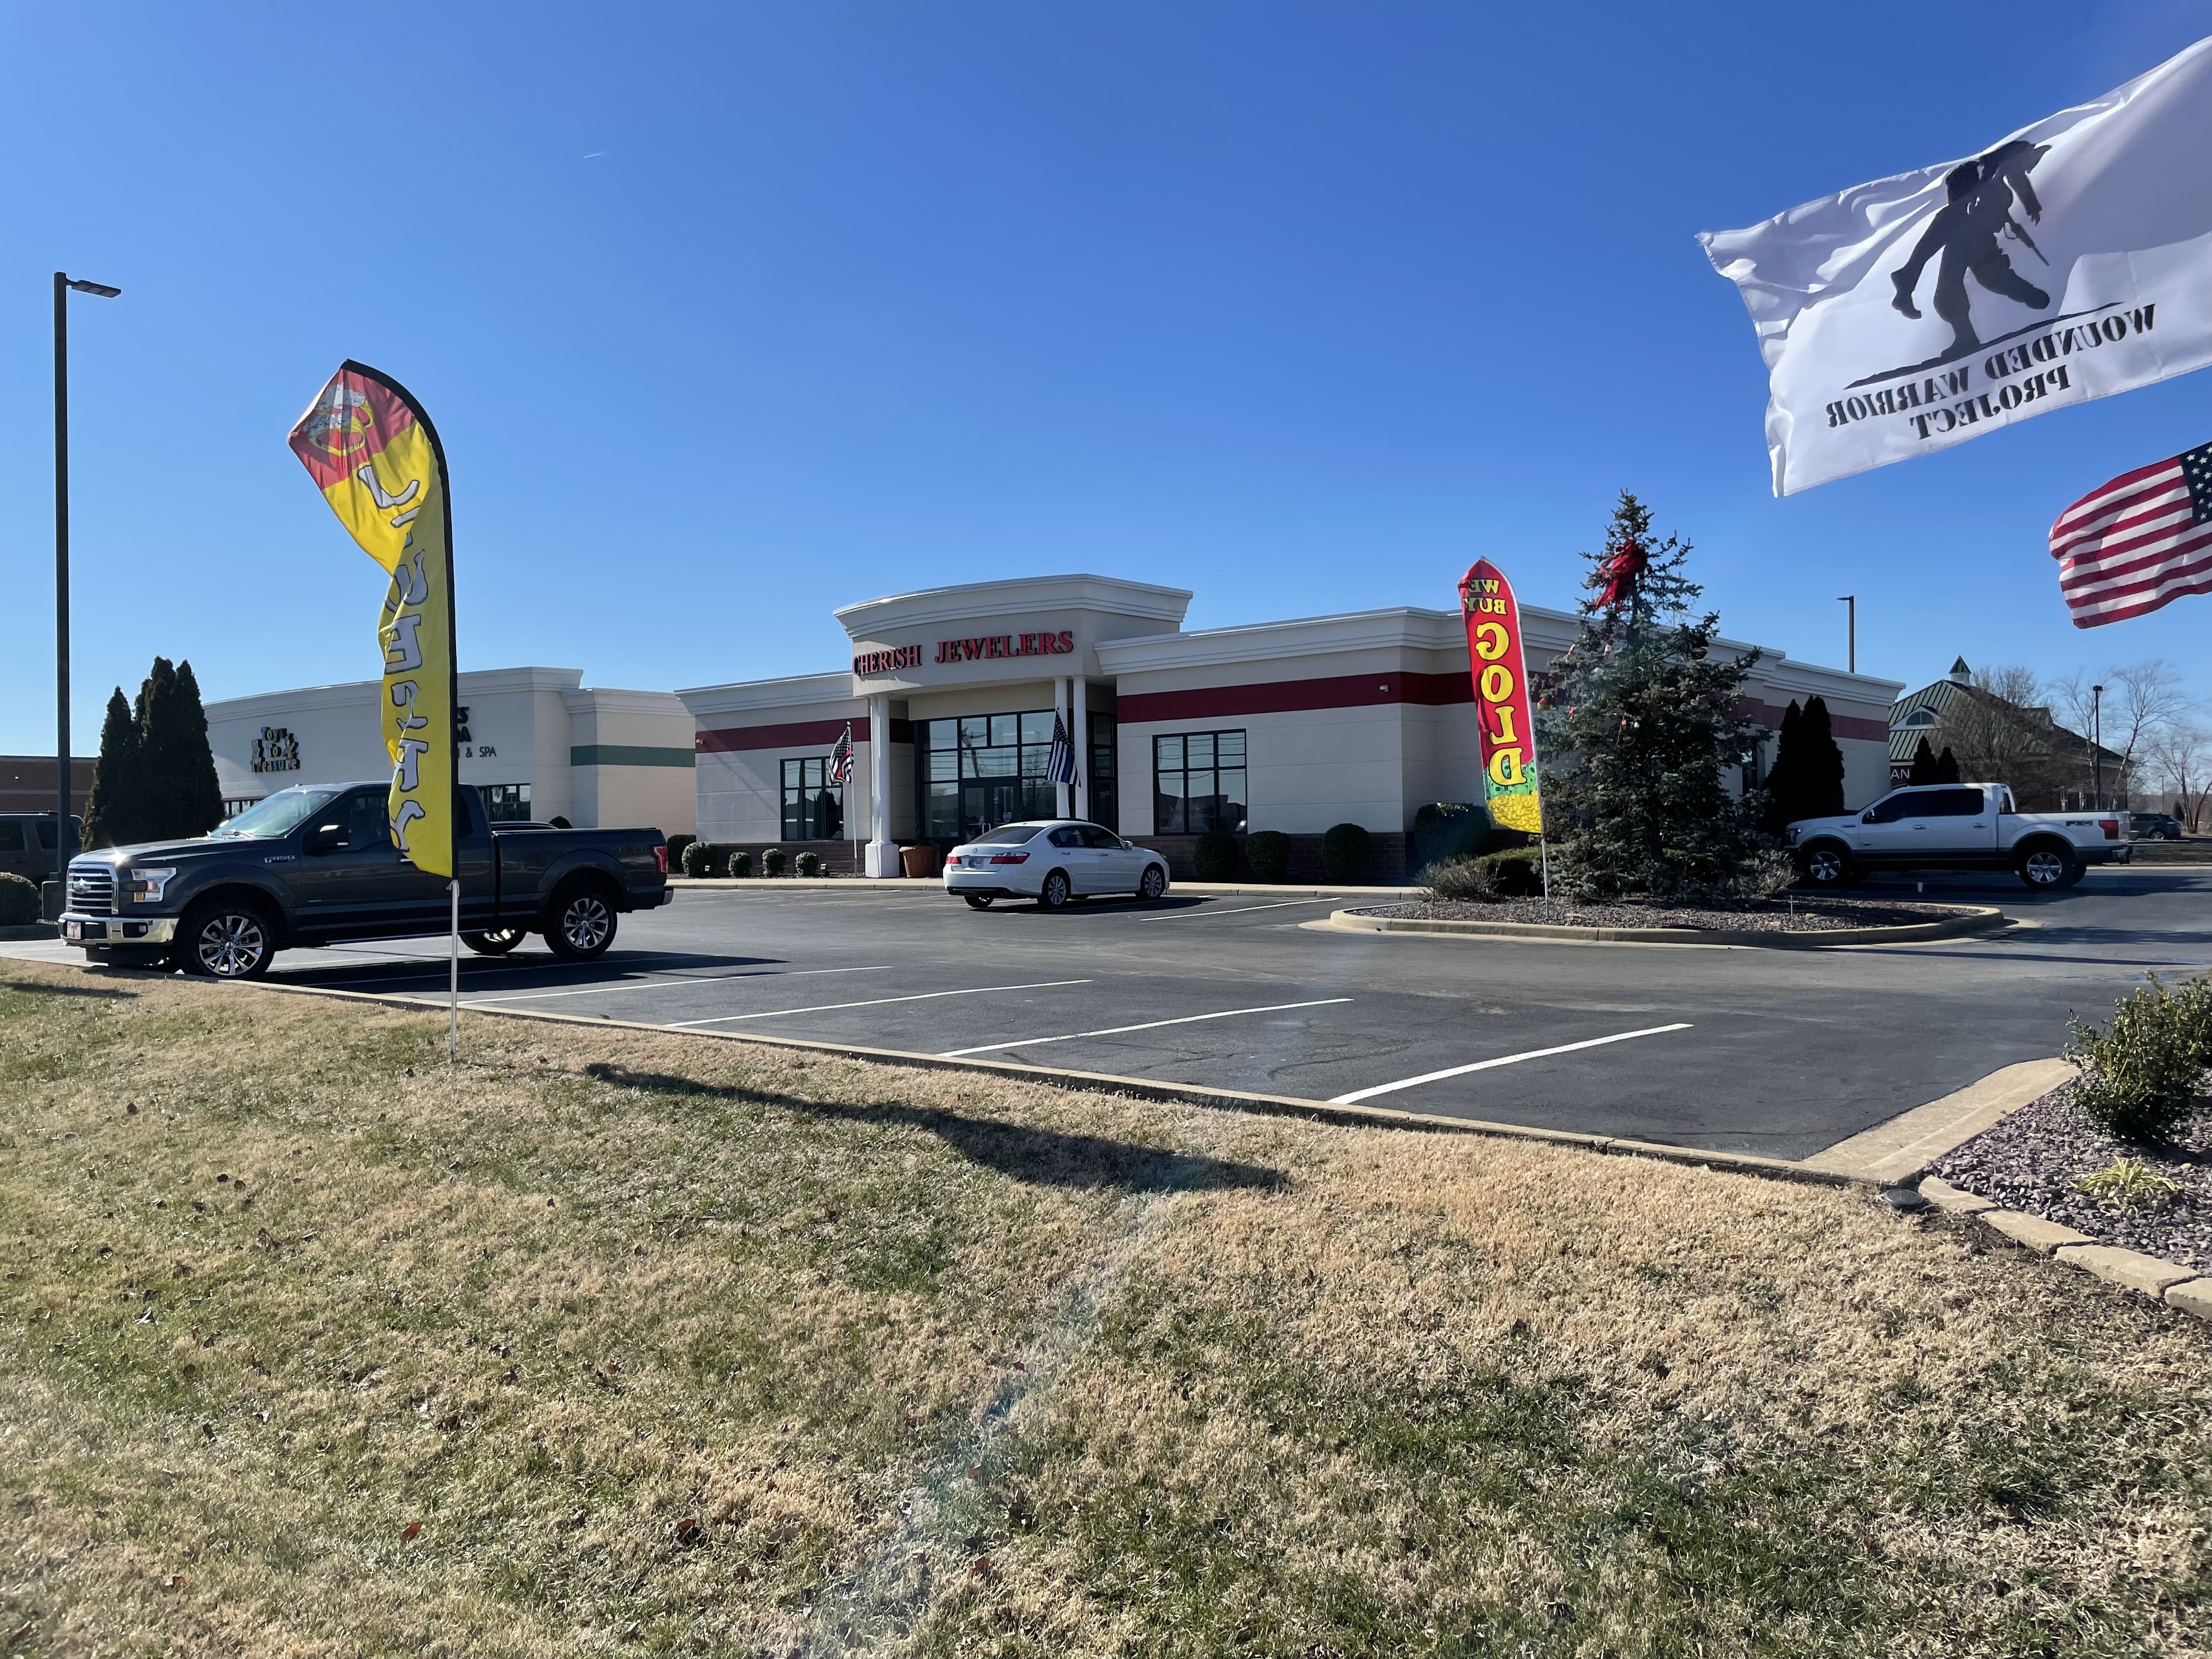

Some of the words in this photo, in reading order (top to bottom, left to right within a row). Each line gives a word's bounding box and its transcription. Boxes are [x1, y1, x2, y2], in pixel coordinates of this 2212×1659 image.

[853, 645, 922, 675] CHERISH
[934, 630, 1074, 663] JEWELERS
[466, 747, 472, 758] &
[479, 746, 496, 757] SPA
